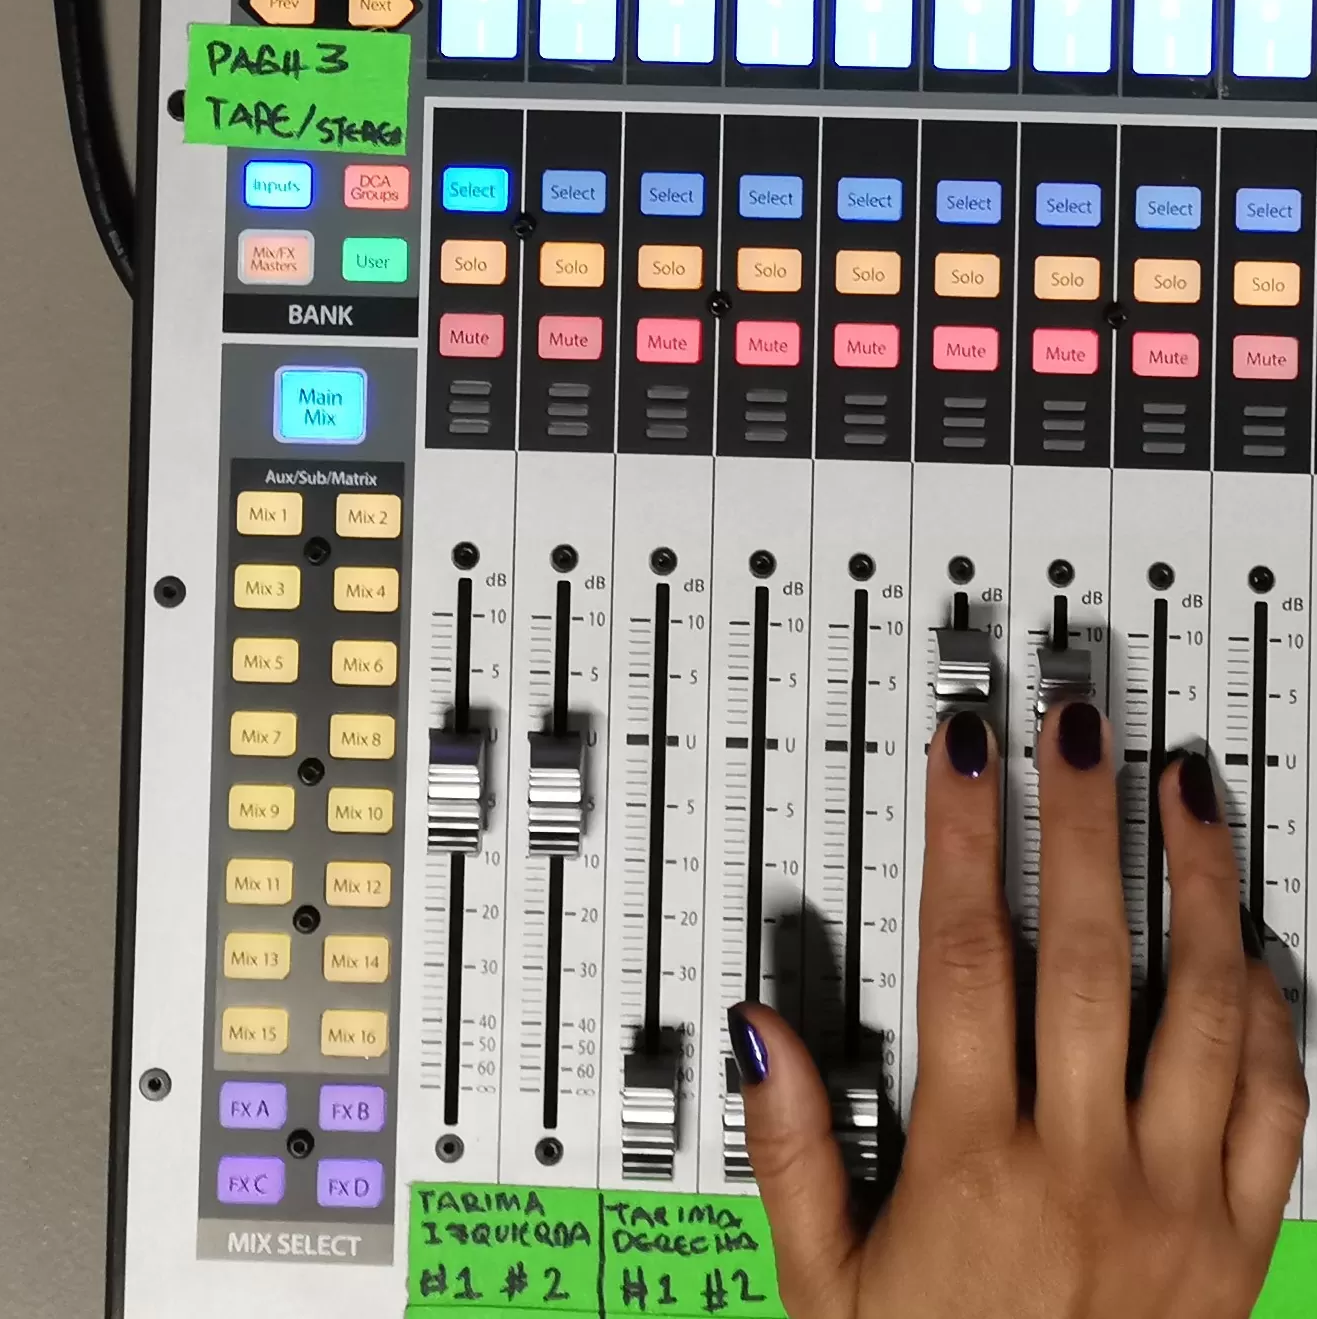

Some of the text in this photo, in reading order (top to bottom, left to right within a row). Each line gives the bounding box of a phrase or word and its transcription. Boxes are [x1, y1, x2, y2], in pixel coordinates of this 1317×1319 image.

[252, 177, 301, 195] Inputs
[447, 181, 496, 199] Select
[356, 253, 391, 269] User
[454, 256, 488, 272] Solo
[288, 303, 354, 327] BANK
[449, 329, 490, 346] Mute
[298, 387, 343, 406] Main
[304, 408, 337, 426] Mix
[264, 468, 378, 487] Aux/Sub/Matrix
[485, 572, 507, 588] dB
[490, 608, 507, 625] 10
[685, 734, 697, 751] U
[335, 804, 384, 822] Mix 10
[227, 1231, 363, 1257] MIX SELECT
